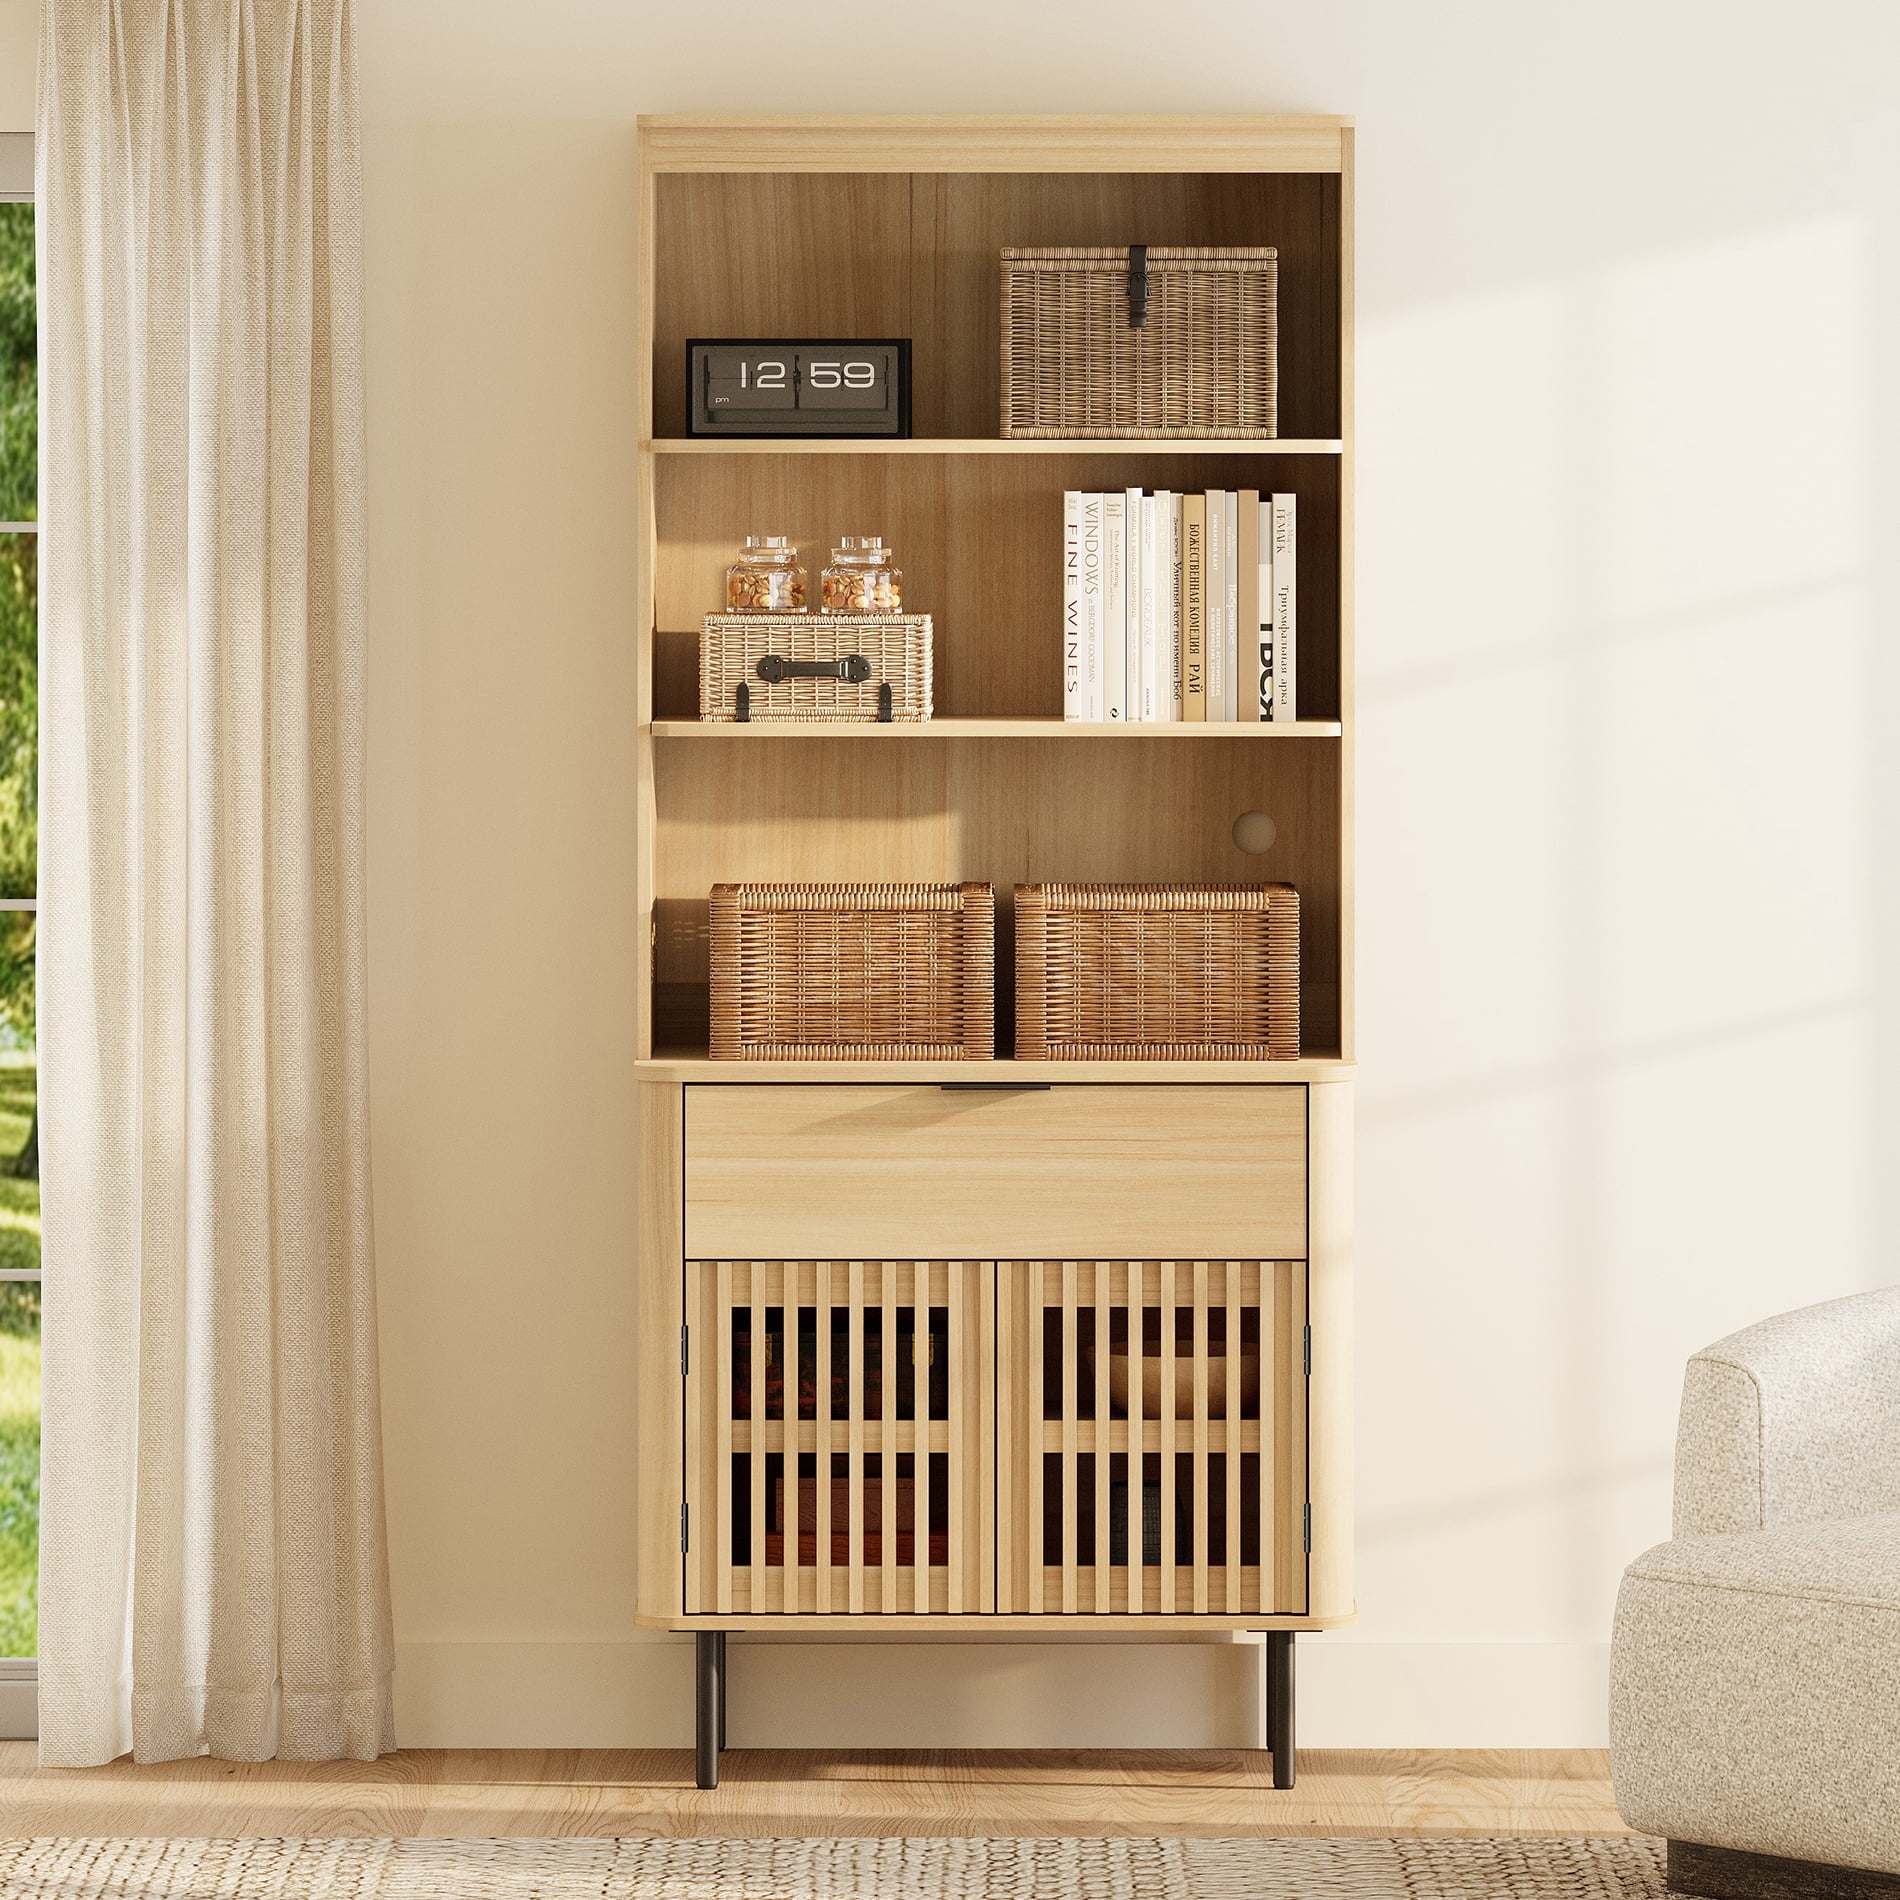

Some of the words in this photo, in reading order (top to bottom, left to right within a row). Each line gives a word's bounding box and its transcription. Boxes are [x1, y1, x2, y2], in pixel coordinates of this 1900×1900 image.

[741, 362, 786, 388] 12
[810, 362, 875, 388] 59
[1068, 524, 1078, 585] FINE
[1085, 501, 1098, 595] WINDOWS
[1189, 524, 1200, 603] БОЖЕСТВЕННАЯ
[1173, 561, 1182, 608] Уличный
[1144, 588, 1152, 646] BORDEAUX
[1173, 631, 1180, 644] по
[1188, 606, 1200, 654] КОМЕДИЯ
[1278, 585, 1290, 674] Триумфальная
[1068, 600, 1078, 693] WINES
[1173, 680, 1182, 700] Боб
[1189, 664, 1203, 693] РАЙ
[1278, 678, 1288, 705] арка
